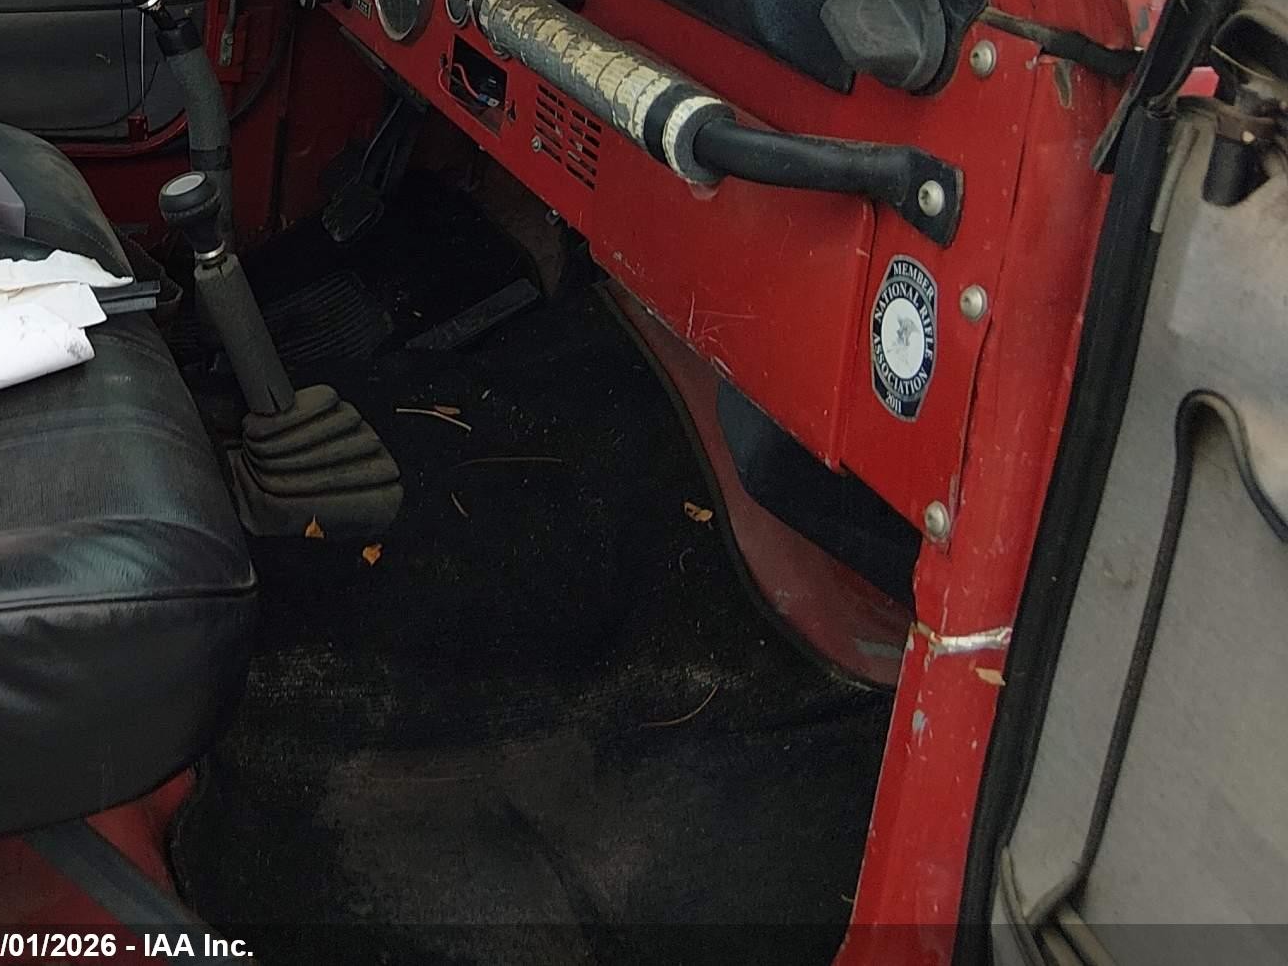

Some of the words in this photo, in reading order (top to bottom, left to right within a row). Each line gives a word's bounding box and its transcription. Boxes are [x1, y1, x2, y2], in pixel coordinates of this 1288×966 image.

[892, 261, 935, 301] MEMBER
[874, 282, 920, 323] NATIONAL
[919, 304, 934, 362] RIFLE
[872, 332, 929, 396] ASSOCIATION
[885, 391, 903, 414] 2011
